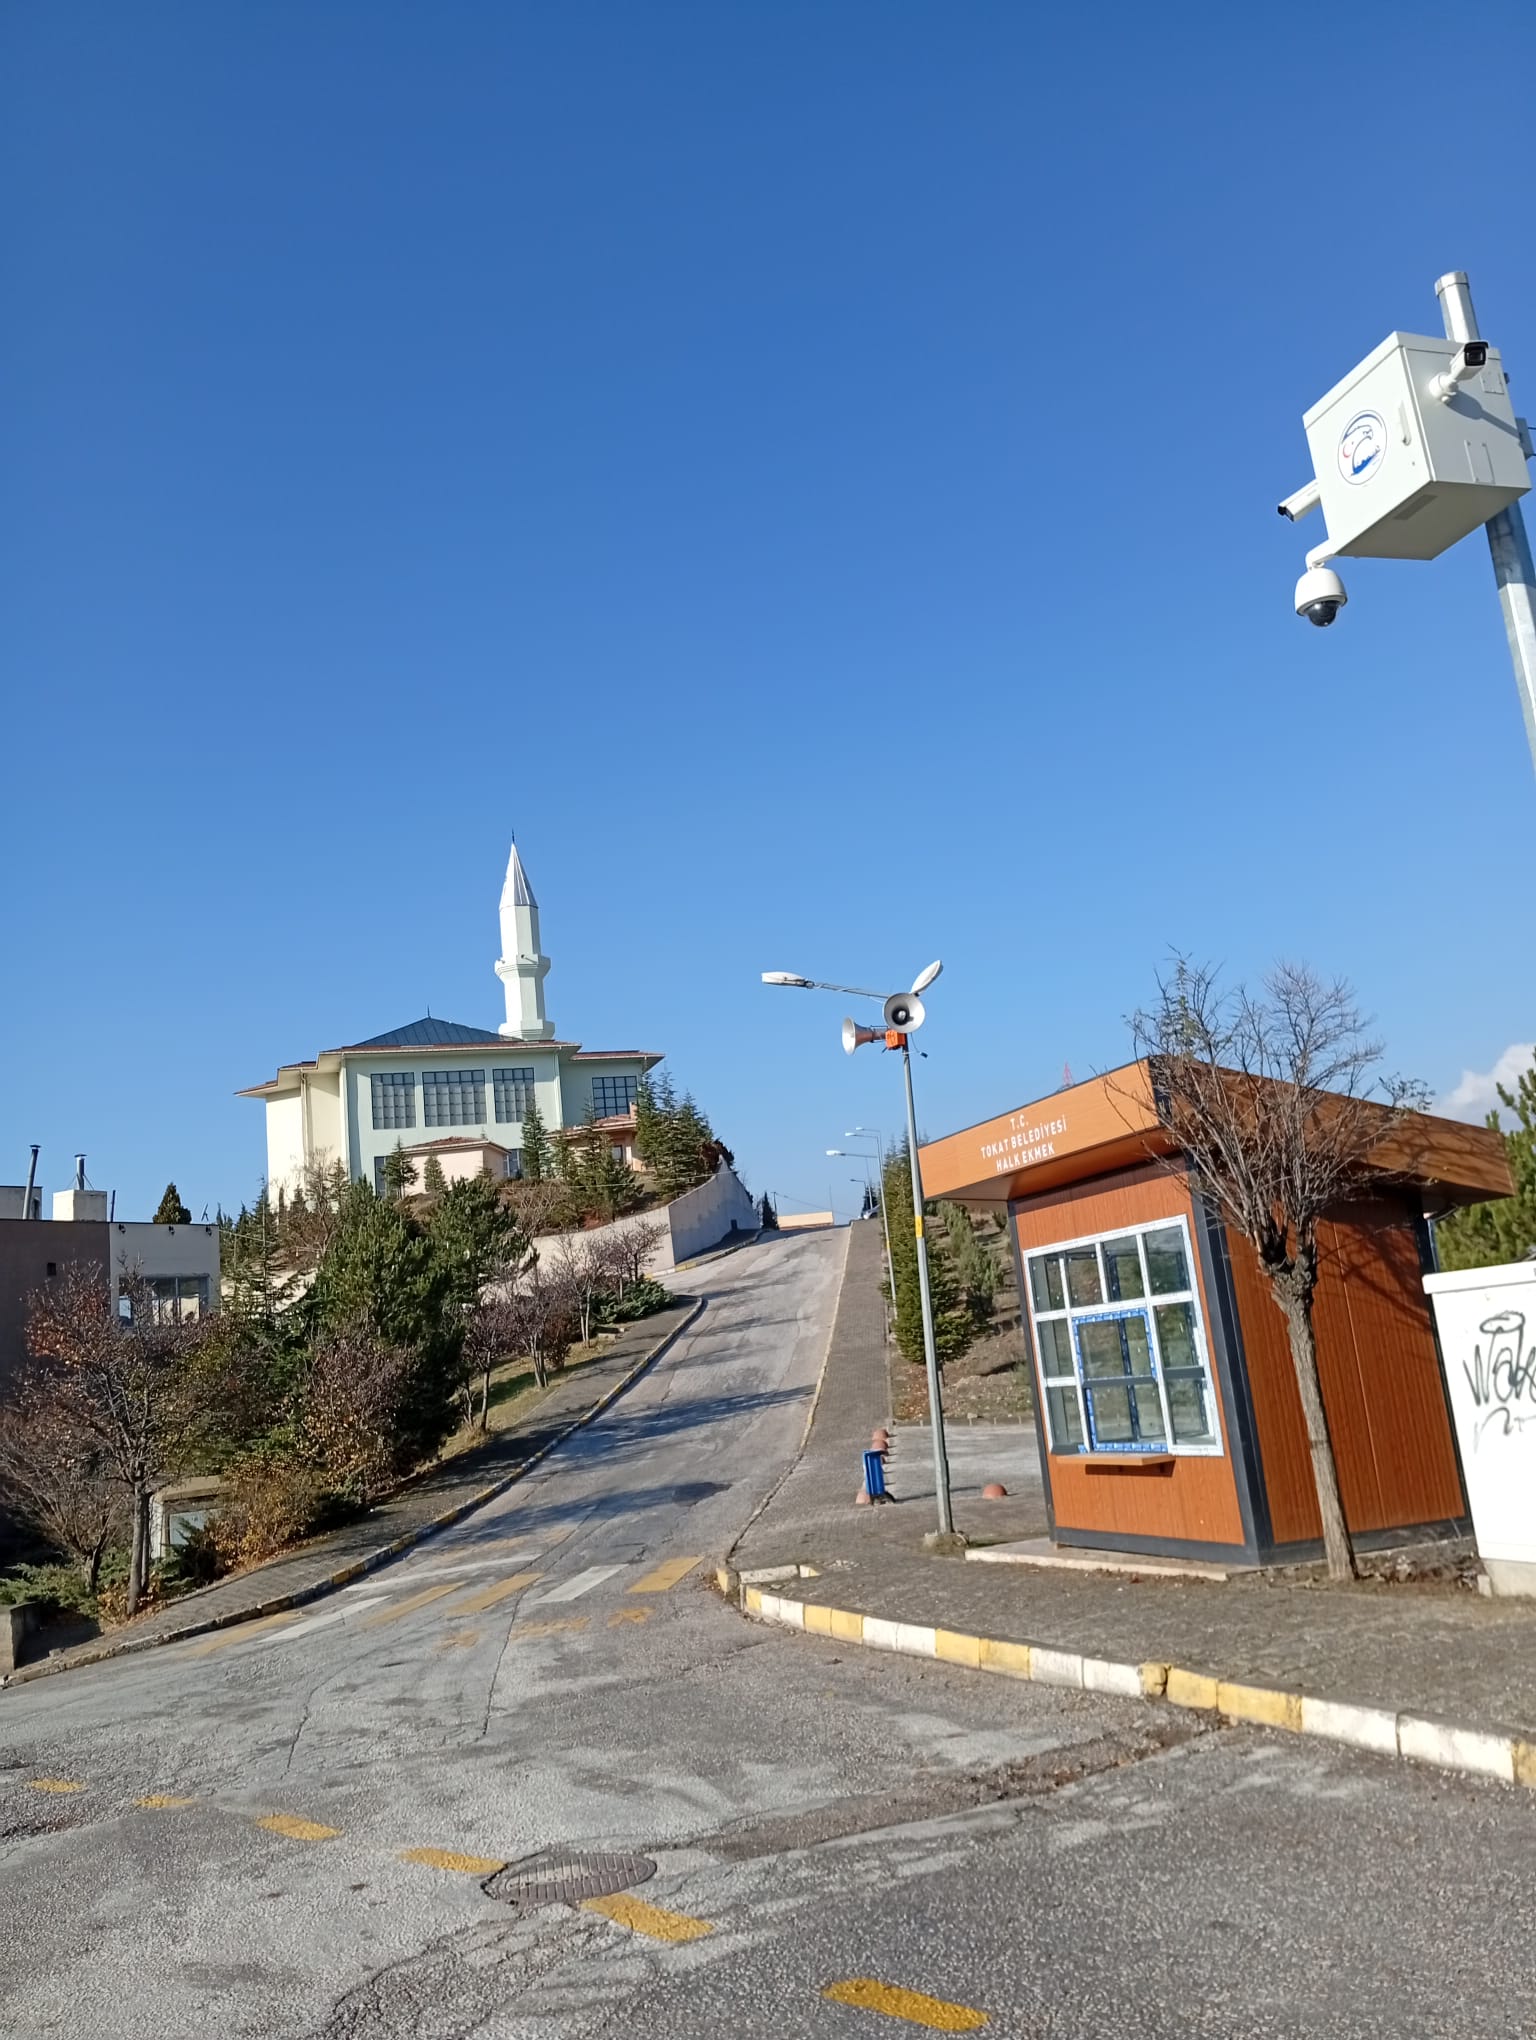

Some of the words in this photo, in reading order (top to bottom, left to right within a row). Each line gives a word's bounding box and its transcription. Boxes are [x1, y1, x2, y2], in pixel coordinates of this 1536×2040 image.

[980, 1138, 1009, 1159] TOKAT
[1010, 1114, 1067, 1149] BELEDİYESİ
[1010, 1114, 1029, 1131] T.C.
[996, 1152, 1021, 1172] HALK
[1021, 1142, 1055, 1164] EKMEK
